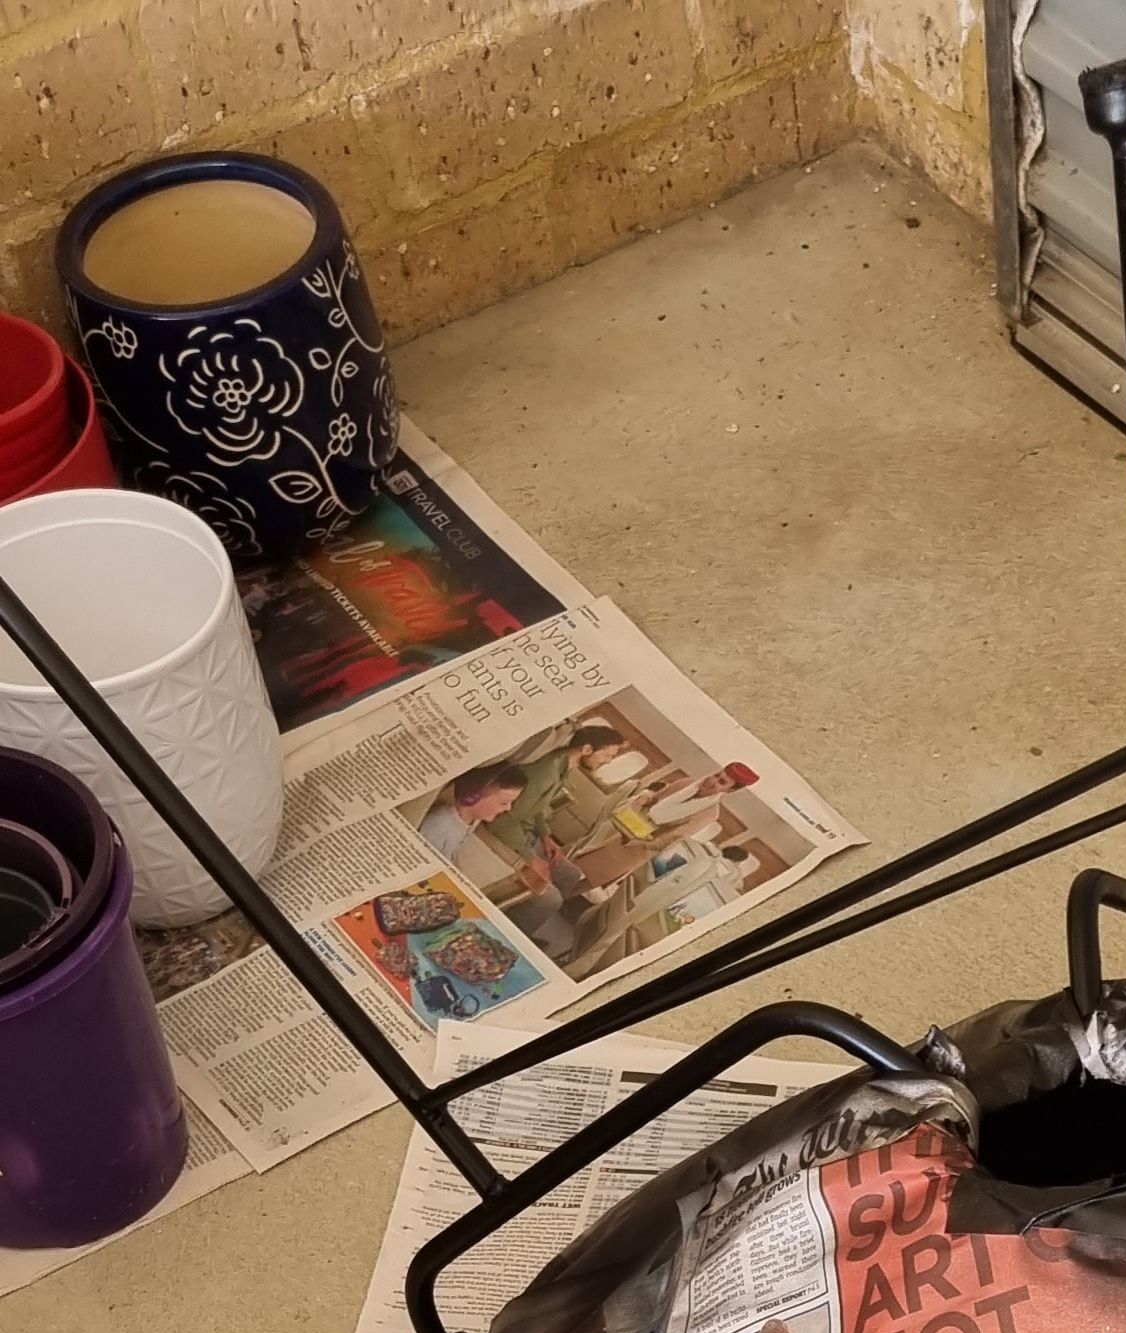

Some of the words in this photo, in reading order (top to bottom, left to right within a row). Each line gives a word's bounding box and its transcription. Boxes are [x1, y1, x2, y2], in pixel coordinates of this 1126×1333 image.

[407, 485, 451, 532] TRAVEL
[446, 522, 483, 560] CLUB
[330, 587, 362, 625] TICKETS
[357, 616, 400, 658] AVAILABLE
[498, 657, 546, 699] your
[512, 632, 541, 656] he
[535, 655, 577, 693] seat
[540, 619, 588, 669] lying
[582, 663, 612, 690] by
[457, 688, 492, 723] fun
[466, 659, 508, 702] ants
[502, 699, 525, 718] is
